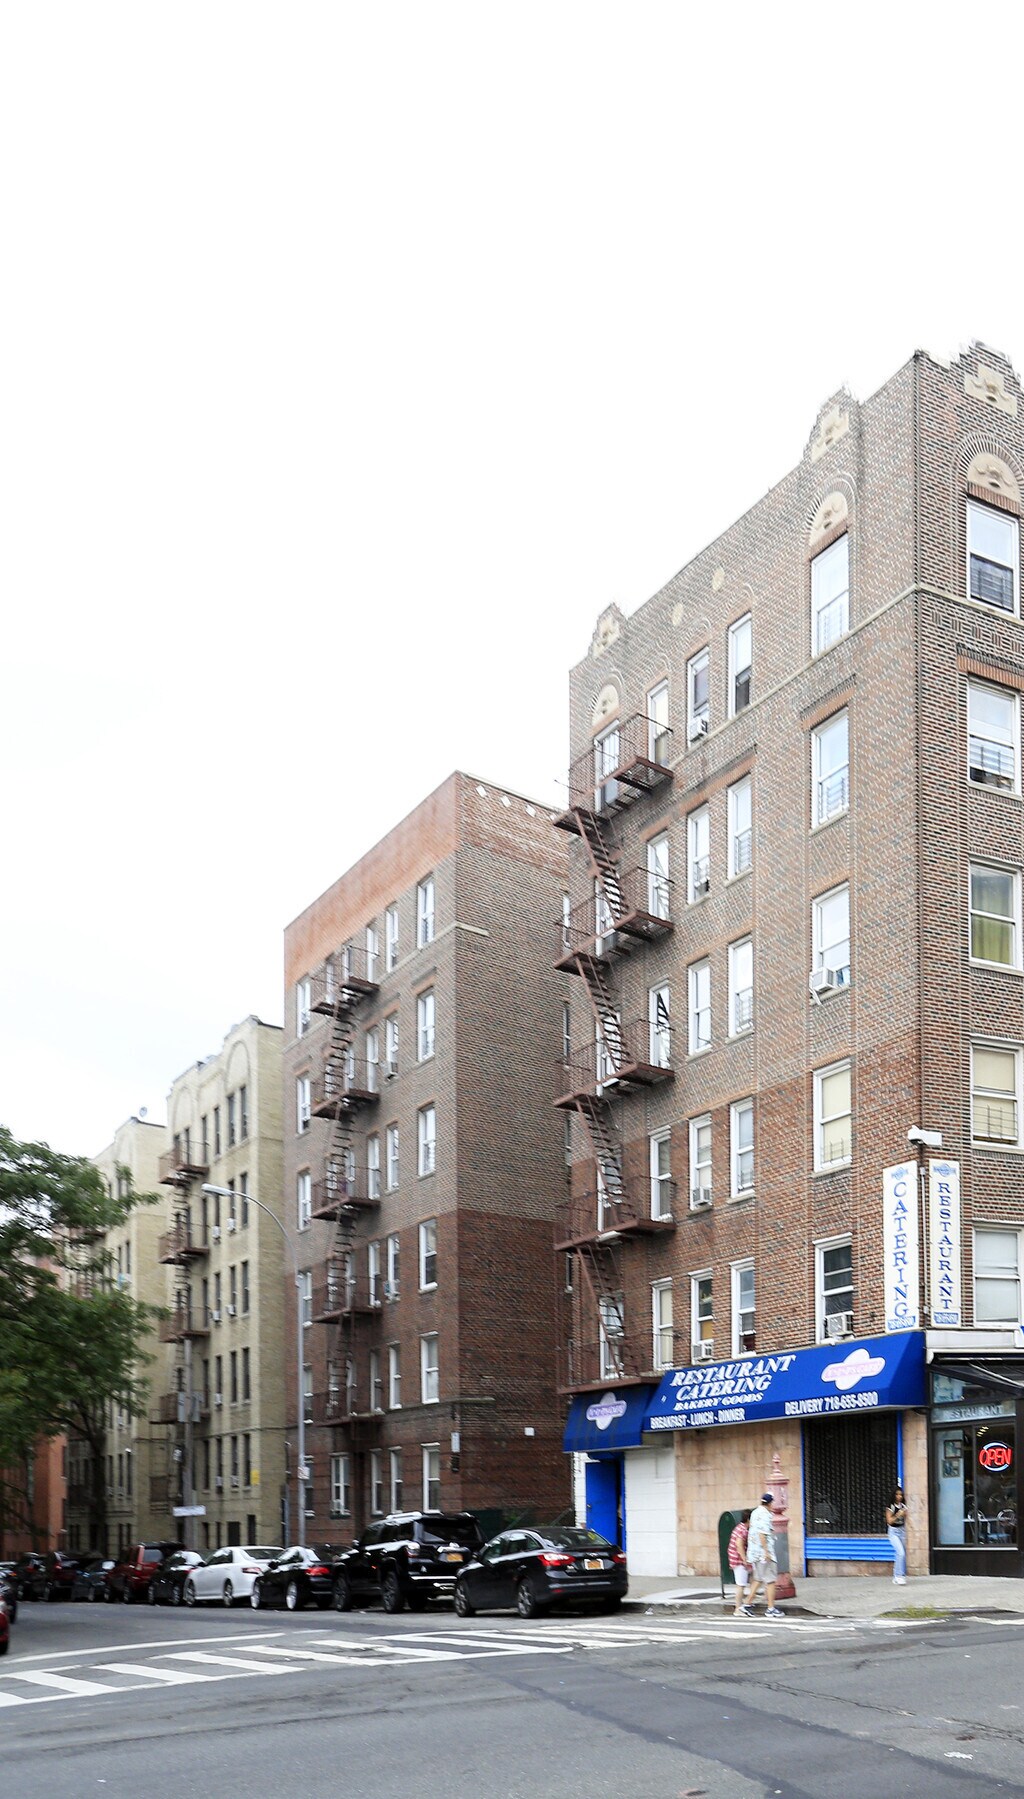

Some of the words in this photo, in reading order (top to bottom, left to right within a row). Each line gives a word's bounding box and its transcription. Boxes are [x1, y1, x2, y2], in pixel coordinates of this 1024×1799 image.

[892, 1182, 909, 1319] CATERING
[937, 1182, 954, 1309] RESTAURANT
[670, 1354, 797, 1387] RESTAURANT
[675, 1374, 773, 1401] CATERING
[673, 1396, 720, 1411] BAKERY
[721, 1392, 764, 1406] GOODS
[784, 1398, 823, 1416] DELIVERY
[650, 1414, 687, 1430] BREAKFAST
[690, 1410, 715, 1426] LUNCH
[717, 1407, 746, 1423] DINNER
[979, 1447, 1013, 1466] OPEN
